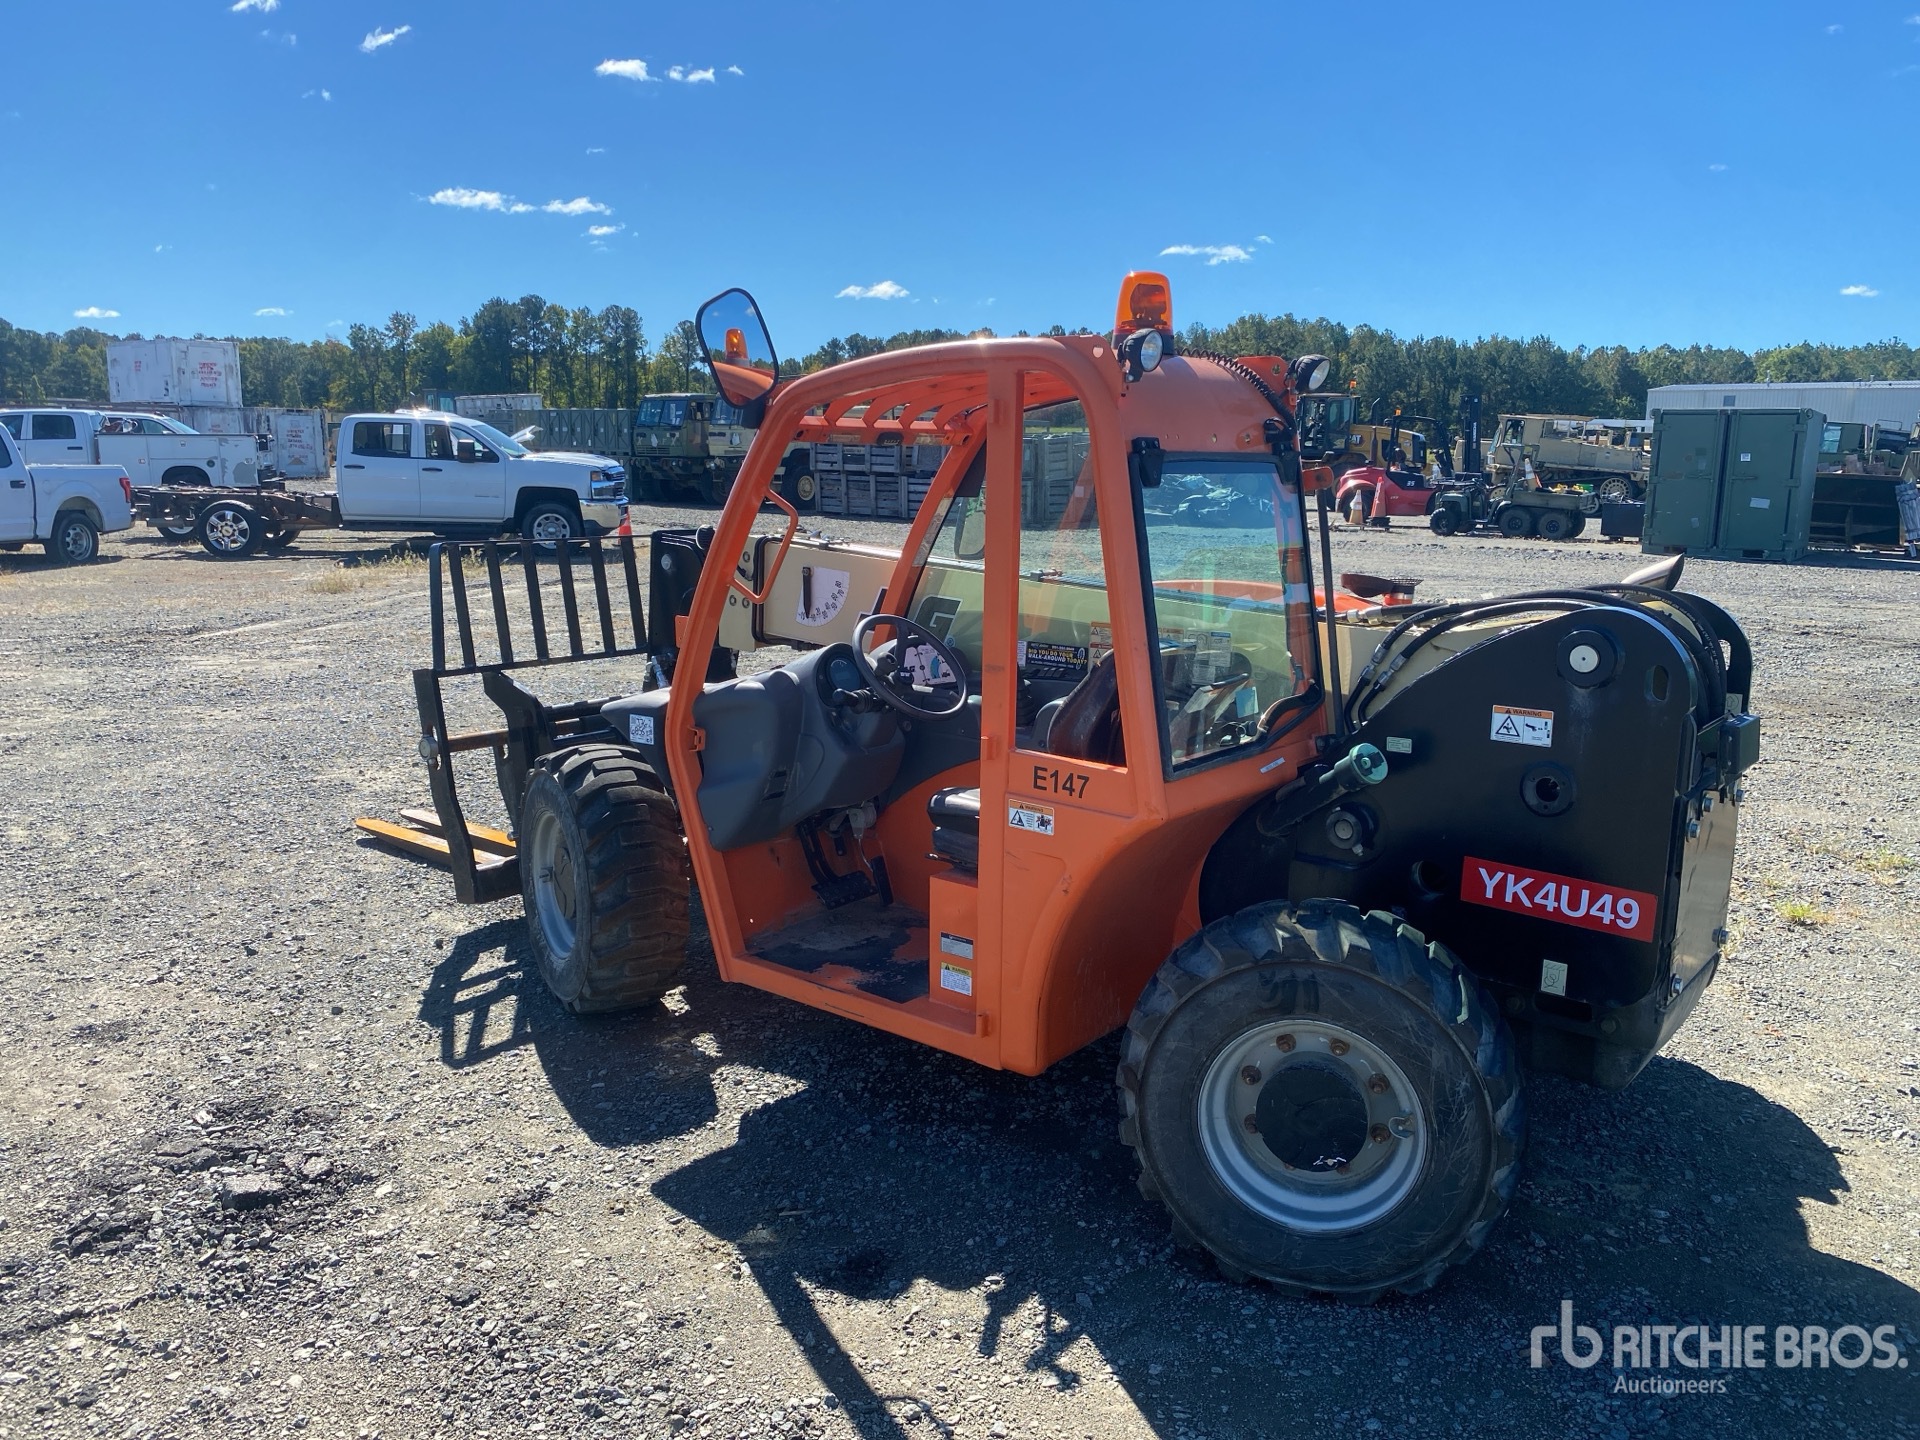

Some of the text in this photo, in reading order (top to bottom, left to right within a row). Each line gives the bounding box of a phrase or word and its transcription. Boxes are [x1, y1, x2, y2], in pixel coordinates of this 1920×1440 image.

[1512, 708, 1542, 717] WARNING
[1033, 766, 1090, 799] E147
[1025, 804, 1044, 813] WARNING
[1478, 867, 1640, 930] YK4U49
[951, 966, 970, 976] WARNING
